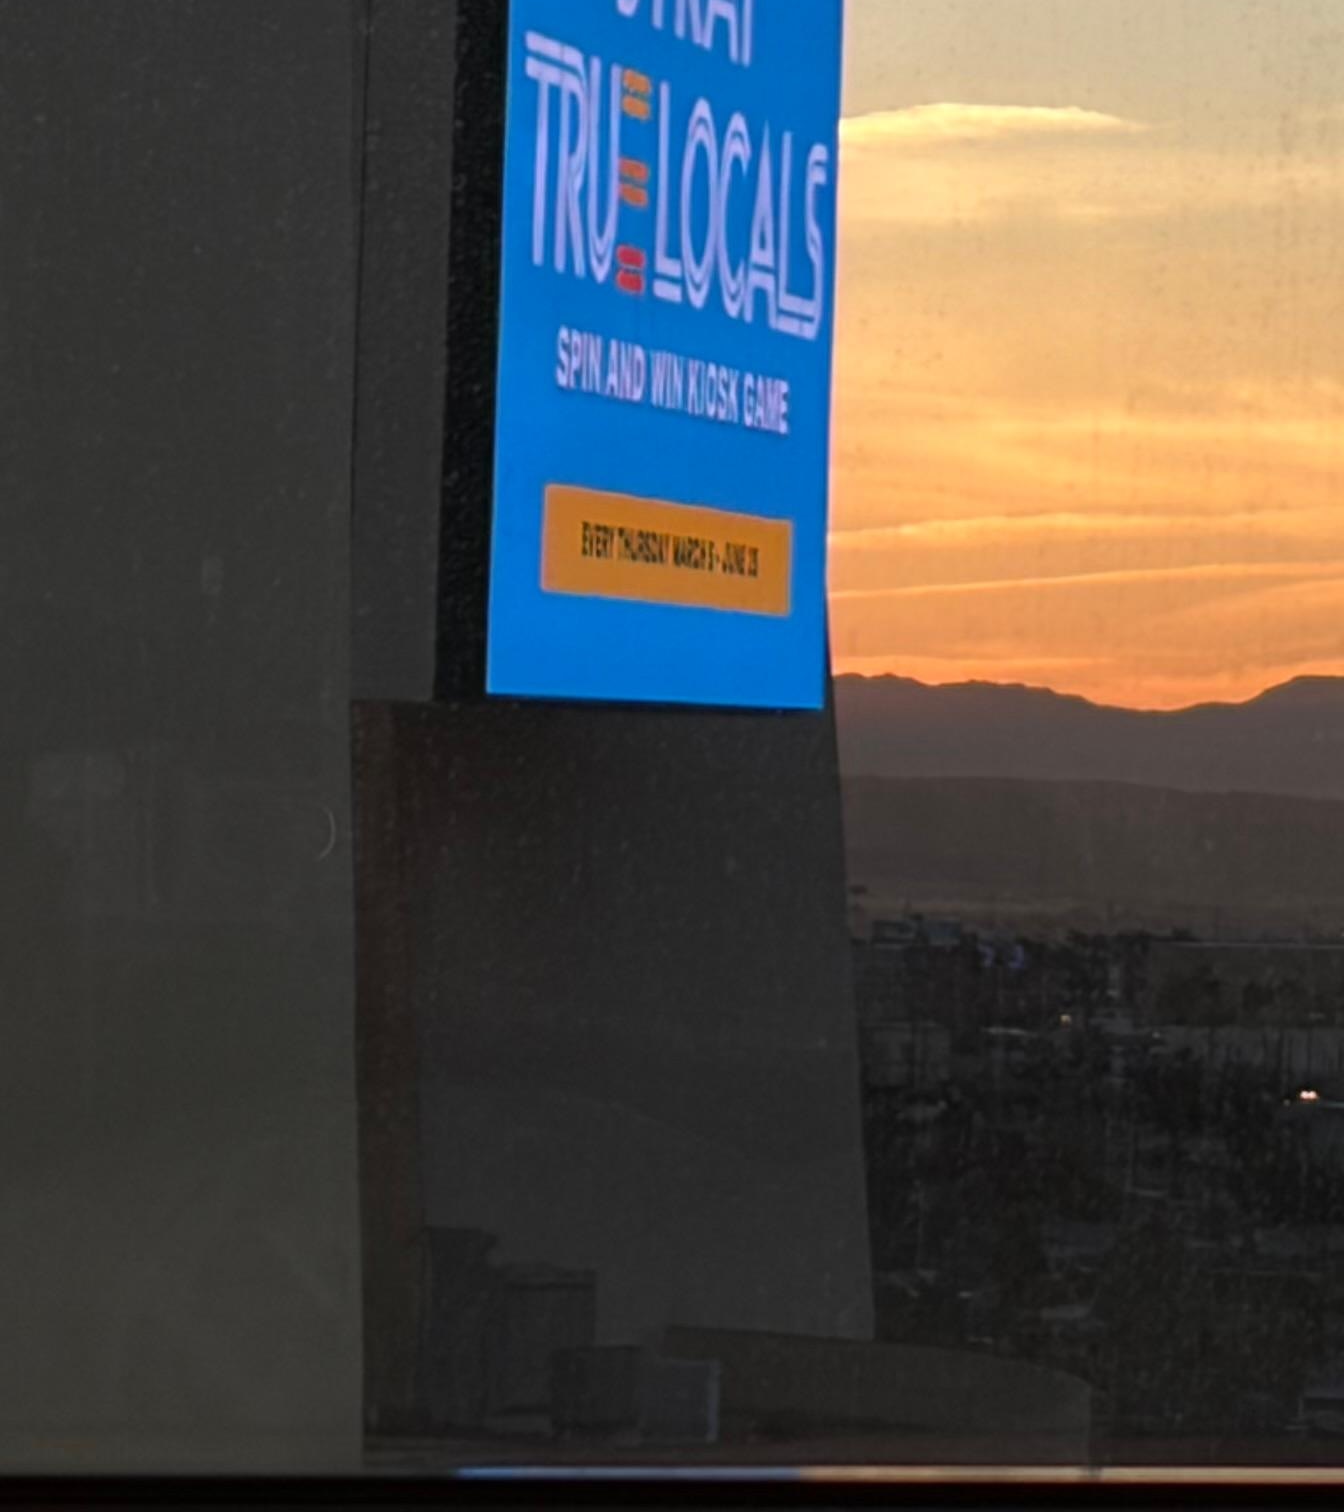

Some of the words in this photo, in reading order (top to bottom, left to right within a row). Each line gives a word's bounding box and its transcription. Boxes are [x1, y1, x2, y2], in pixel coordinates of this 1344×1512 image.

[525, 31, 652, 295] TRUE
[653, 80, 829, 341] LOCALS
[556, 325, 603, 392] SPIN
[604, 338, 646, 402] AND
[650, 350, 685, 409] WIN
[687, 359, 740, 424] KIOSK
[743, 372, 790, 434] GAME
[582, 521, 614, 557] EVERY
[617, 526, 670, 564] THURSDAY
